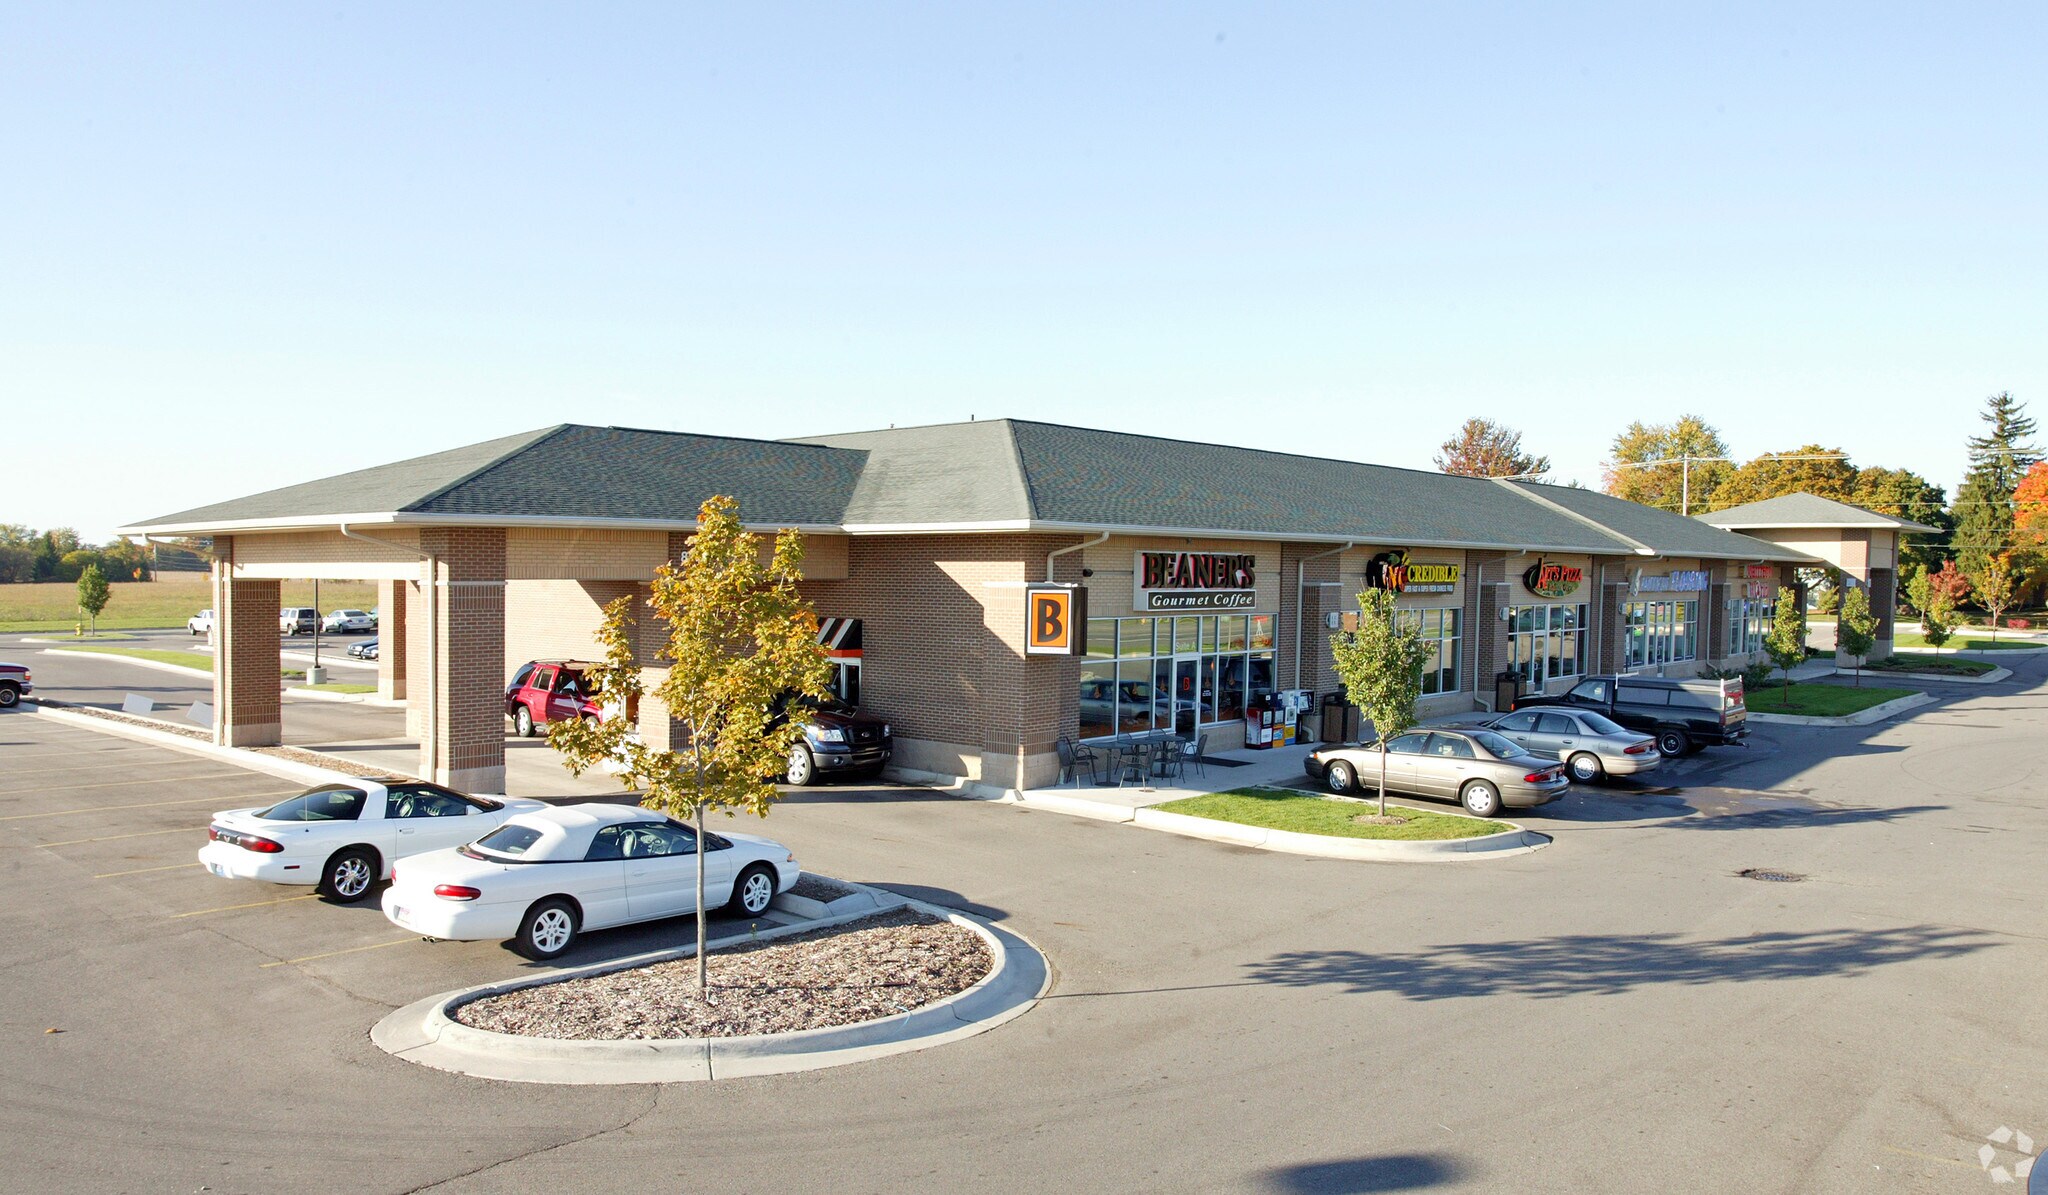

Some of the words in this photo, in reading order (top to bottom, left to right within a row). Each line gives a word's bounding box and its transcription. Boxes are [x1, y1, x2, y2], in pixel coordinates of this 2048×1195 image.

[1141, 552, 1256, 589] BEANER'S
[1152, 595, 1209, 607] Gourmet
[1213, 594, 1253, 607] Coffee
[1037, 598, 1063, 643] B
